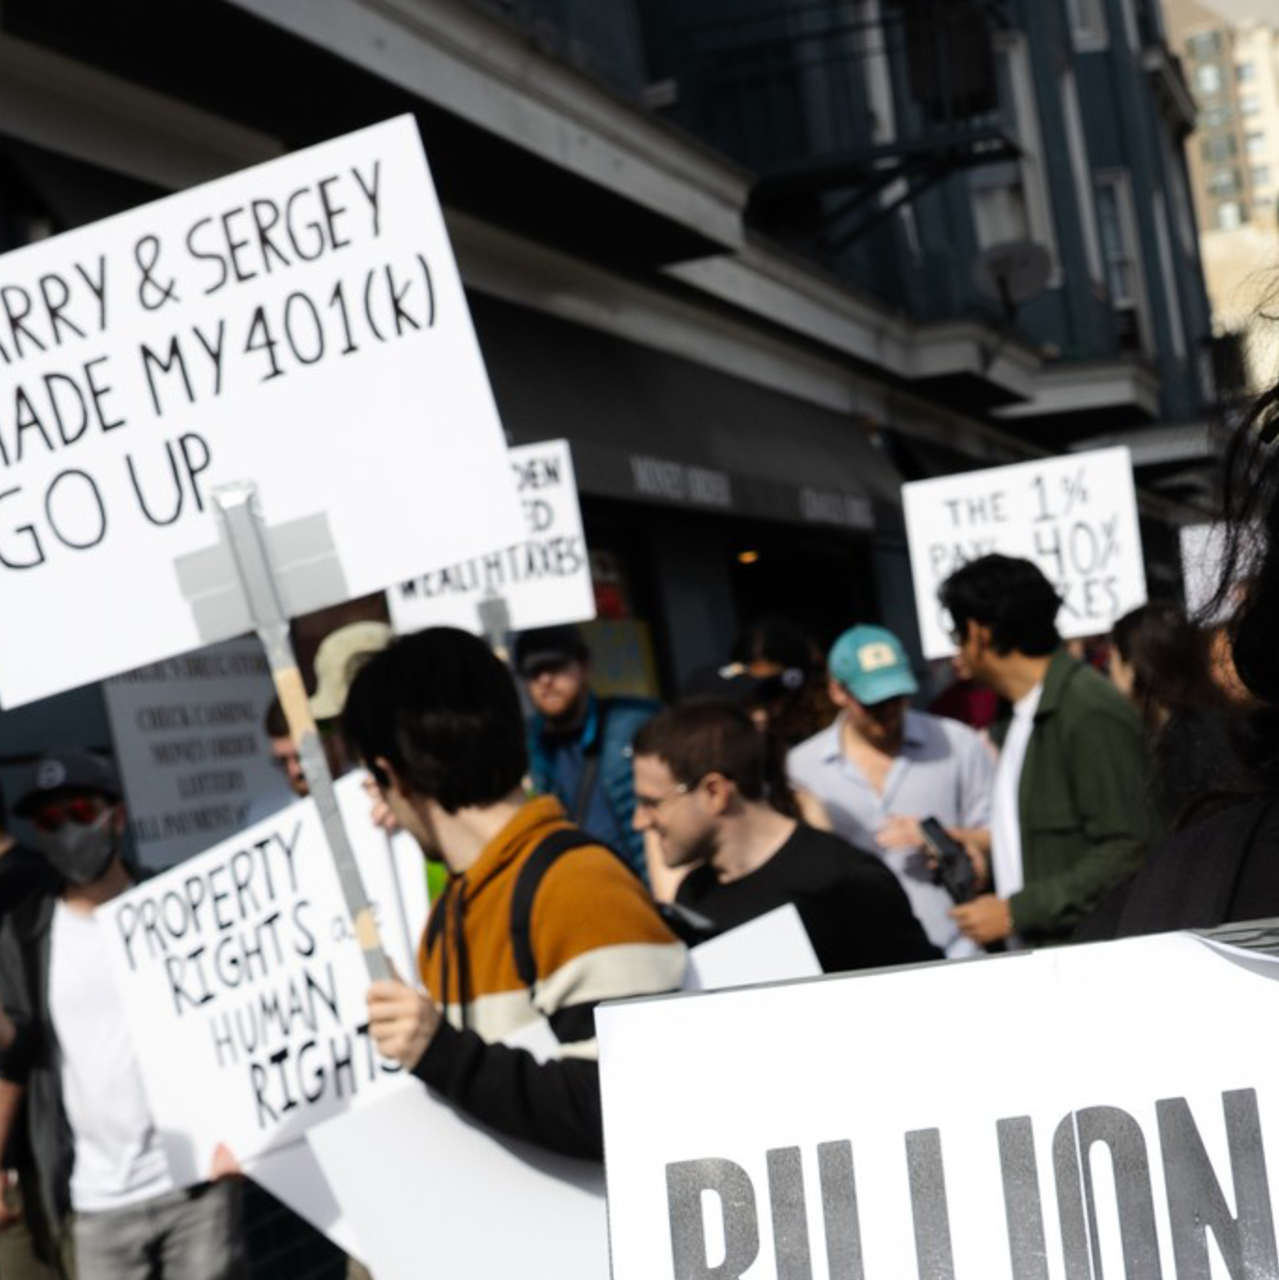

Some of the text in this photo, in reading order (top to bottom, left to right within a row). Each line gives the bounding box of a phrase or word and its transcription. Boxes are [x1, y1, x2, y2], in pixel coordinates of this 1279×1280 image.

[133, 235, 183, 311] &
[185, 160, 382, 294] SERGEY
[139, 320, 225, 416] MY
[126, 431, 212, 527] UP
[943, 491, 1007, 528] THE
[115, 820, 304, 971] PROPERTY
[165, 901, 317, 1016] RIGHTS
[210, 962, 340, 1068] HUMAN
[249, 1024, 405, 1130] RIGHT
